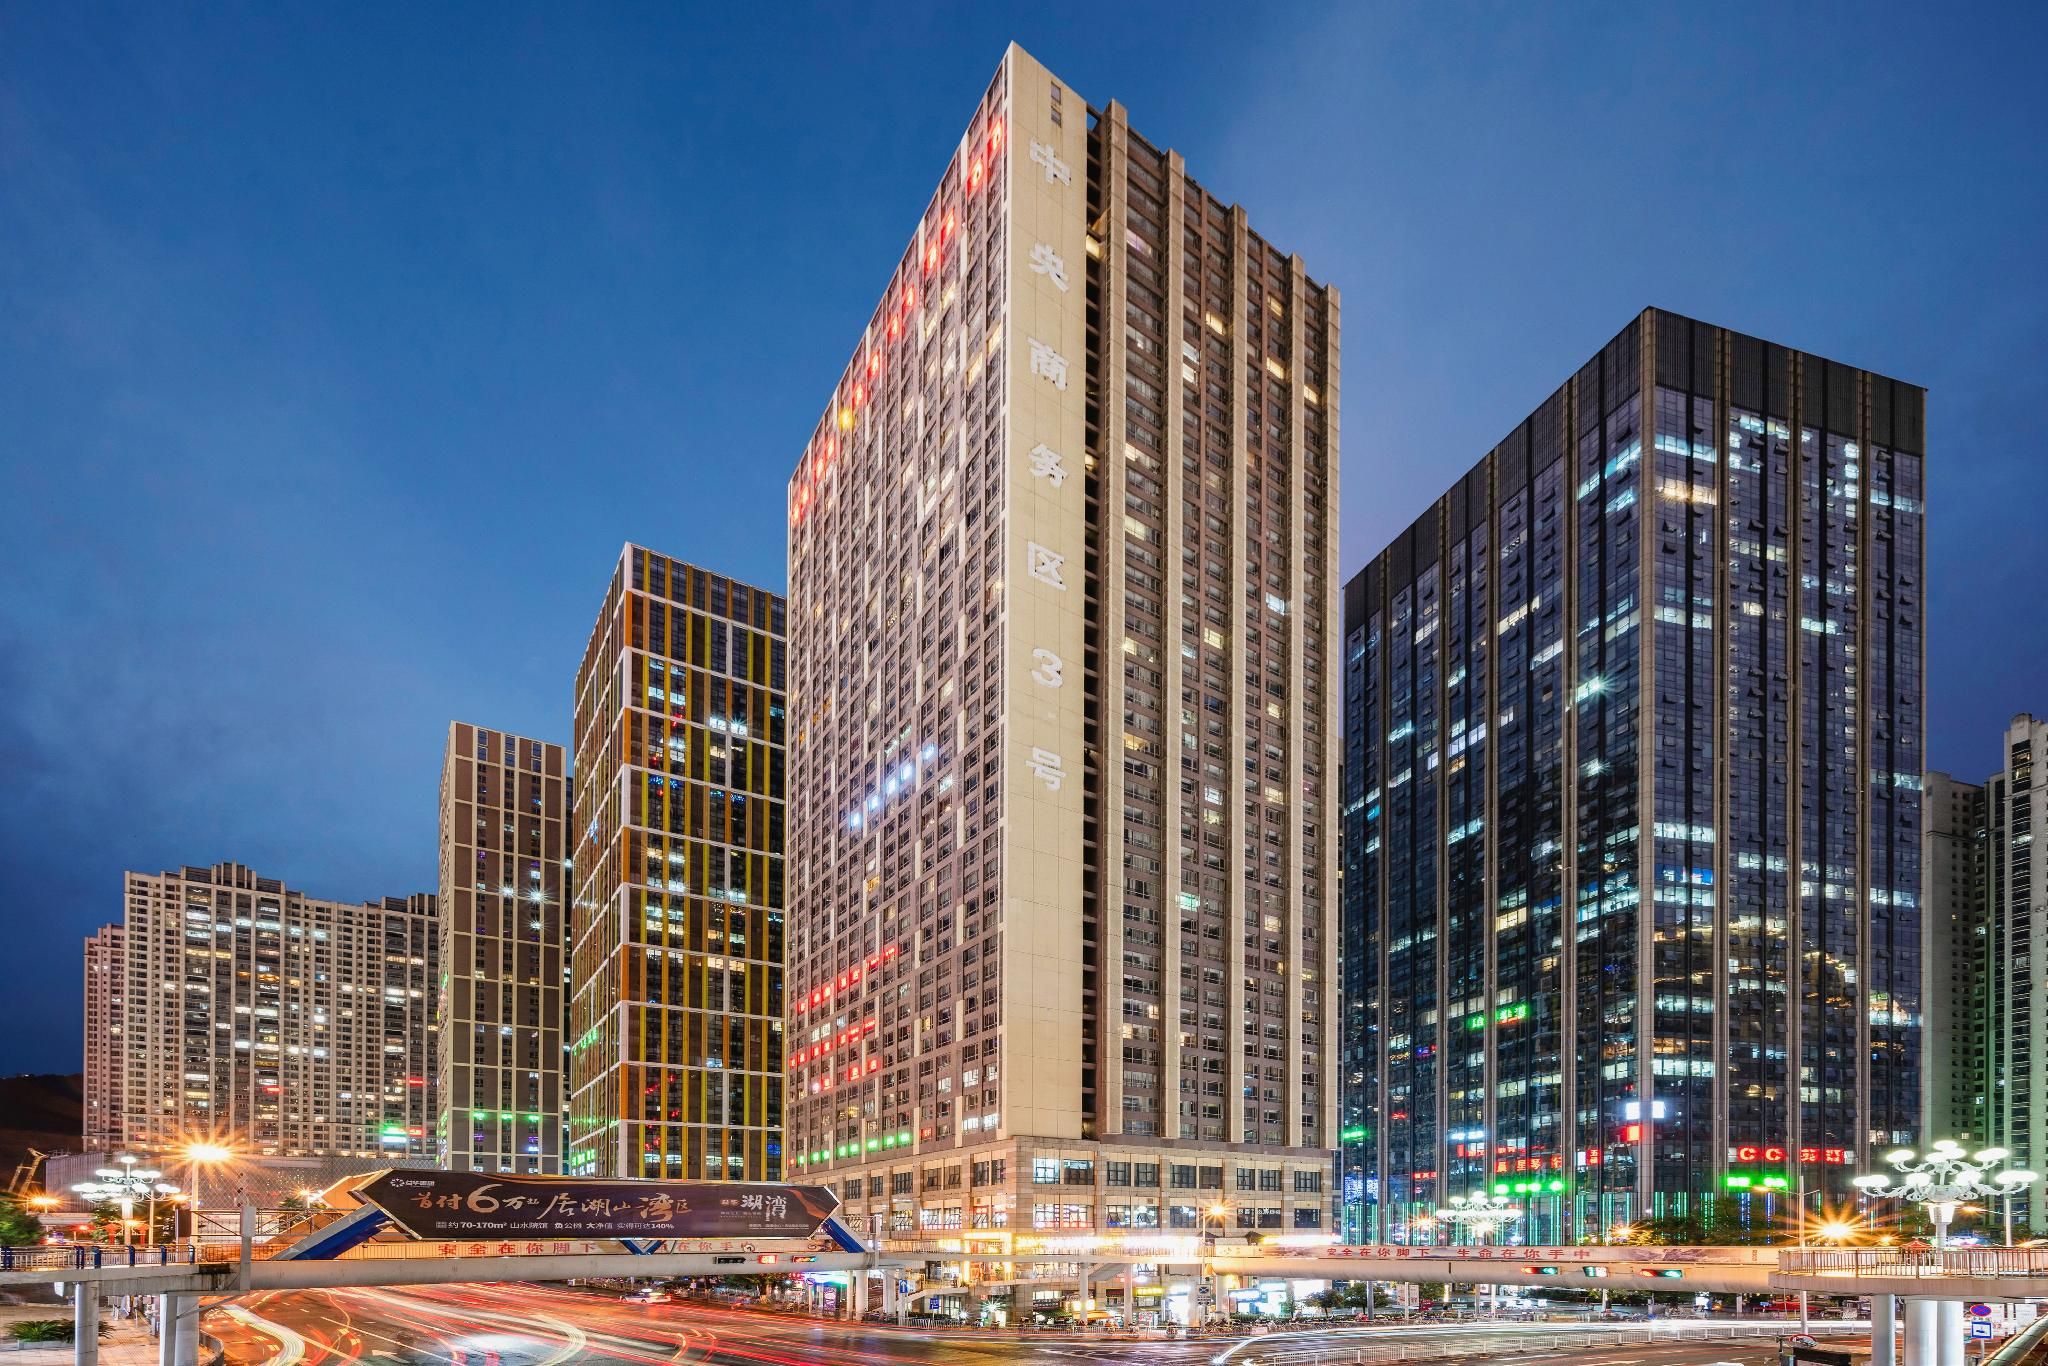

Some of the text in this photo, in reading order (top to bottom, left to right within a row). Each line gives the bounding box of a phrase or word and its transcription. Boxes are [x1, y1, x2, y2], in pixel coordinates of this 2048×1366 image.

[1025, 137, 1071, 792] 中央商务区3号
[438, 1242, 596, 1255] 安全在你脚下
[1327, 1248, 1590, 1259] 安全在你脚下 生命在你手中
